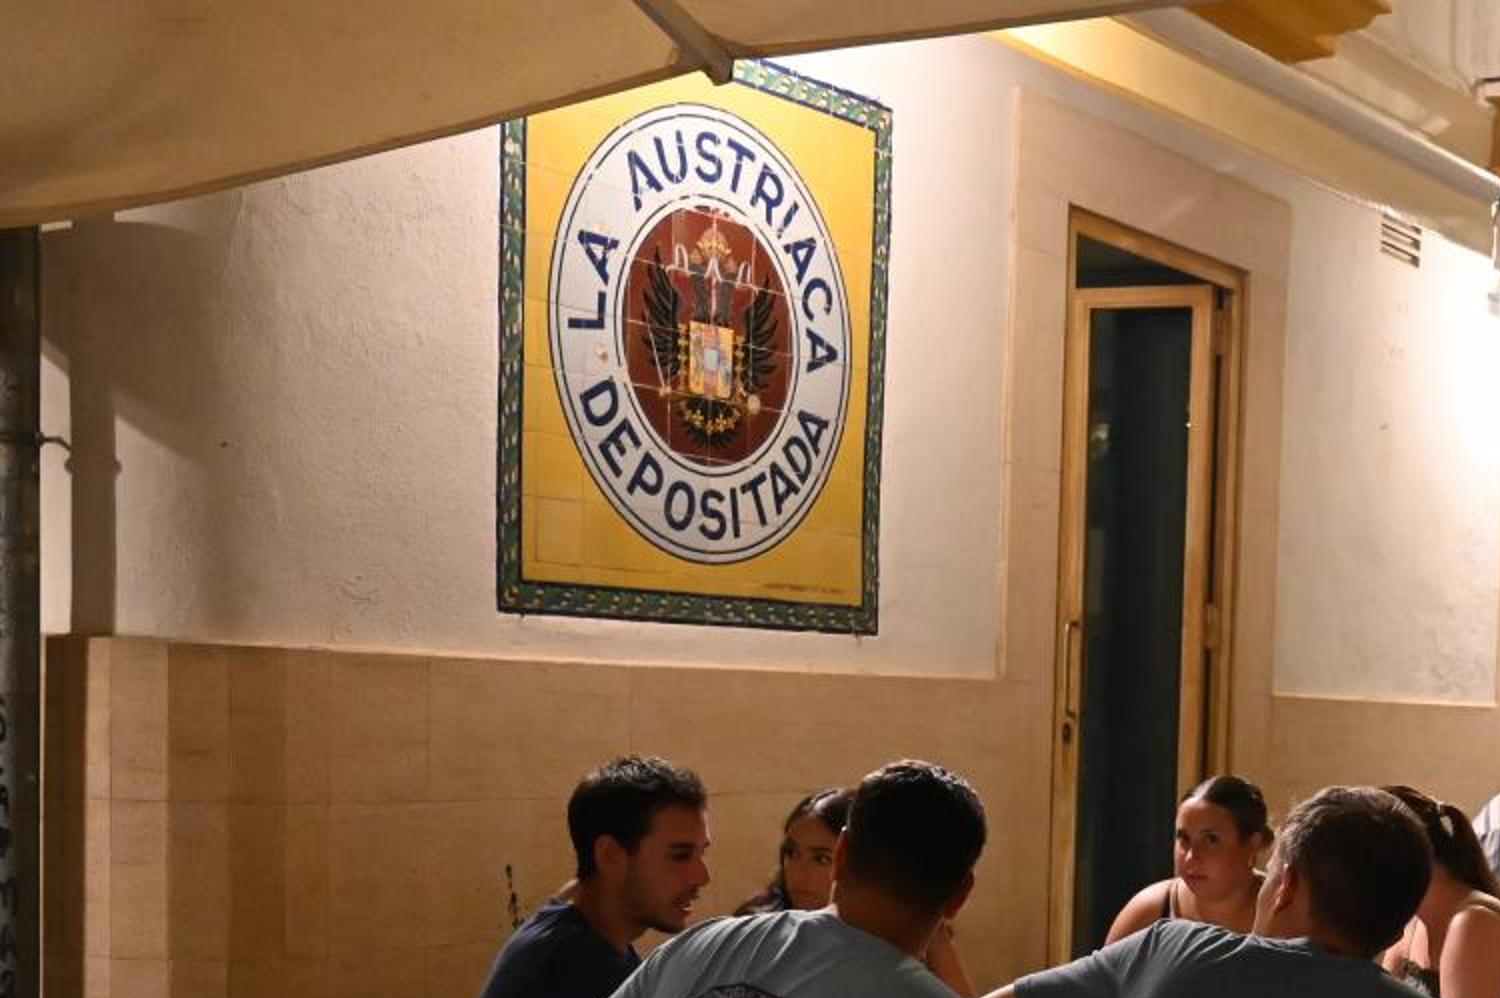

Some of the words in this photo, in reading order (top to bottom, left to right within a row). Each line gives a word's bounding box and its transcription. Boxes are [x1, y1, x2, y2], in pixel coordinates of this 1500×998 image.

[568, 229, 620, 331] LA
[627, 130, 838, 373] AUSTRIACA
[580, 376, 831, 541] DEPOSITADA
